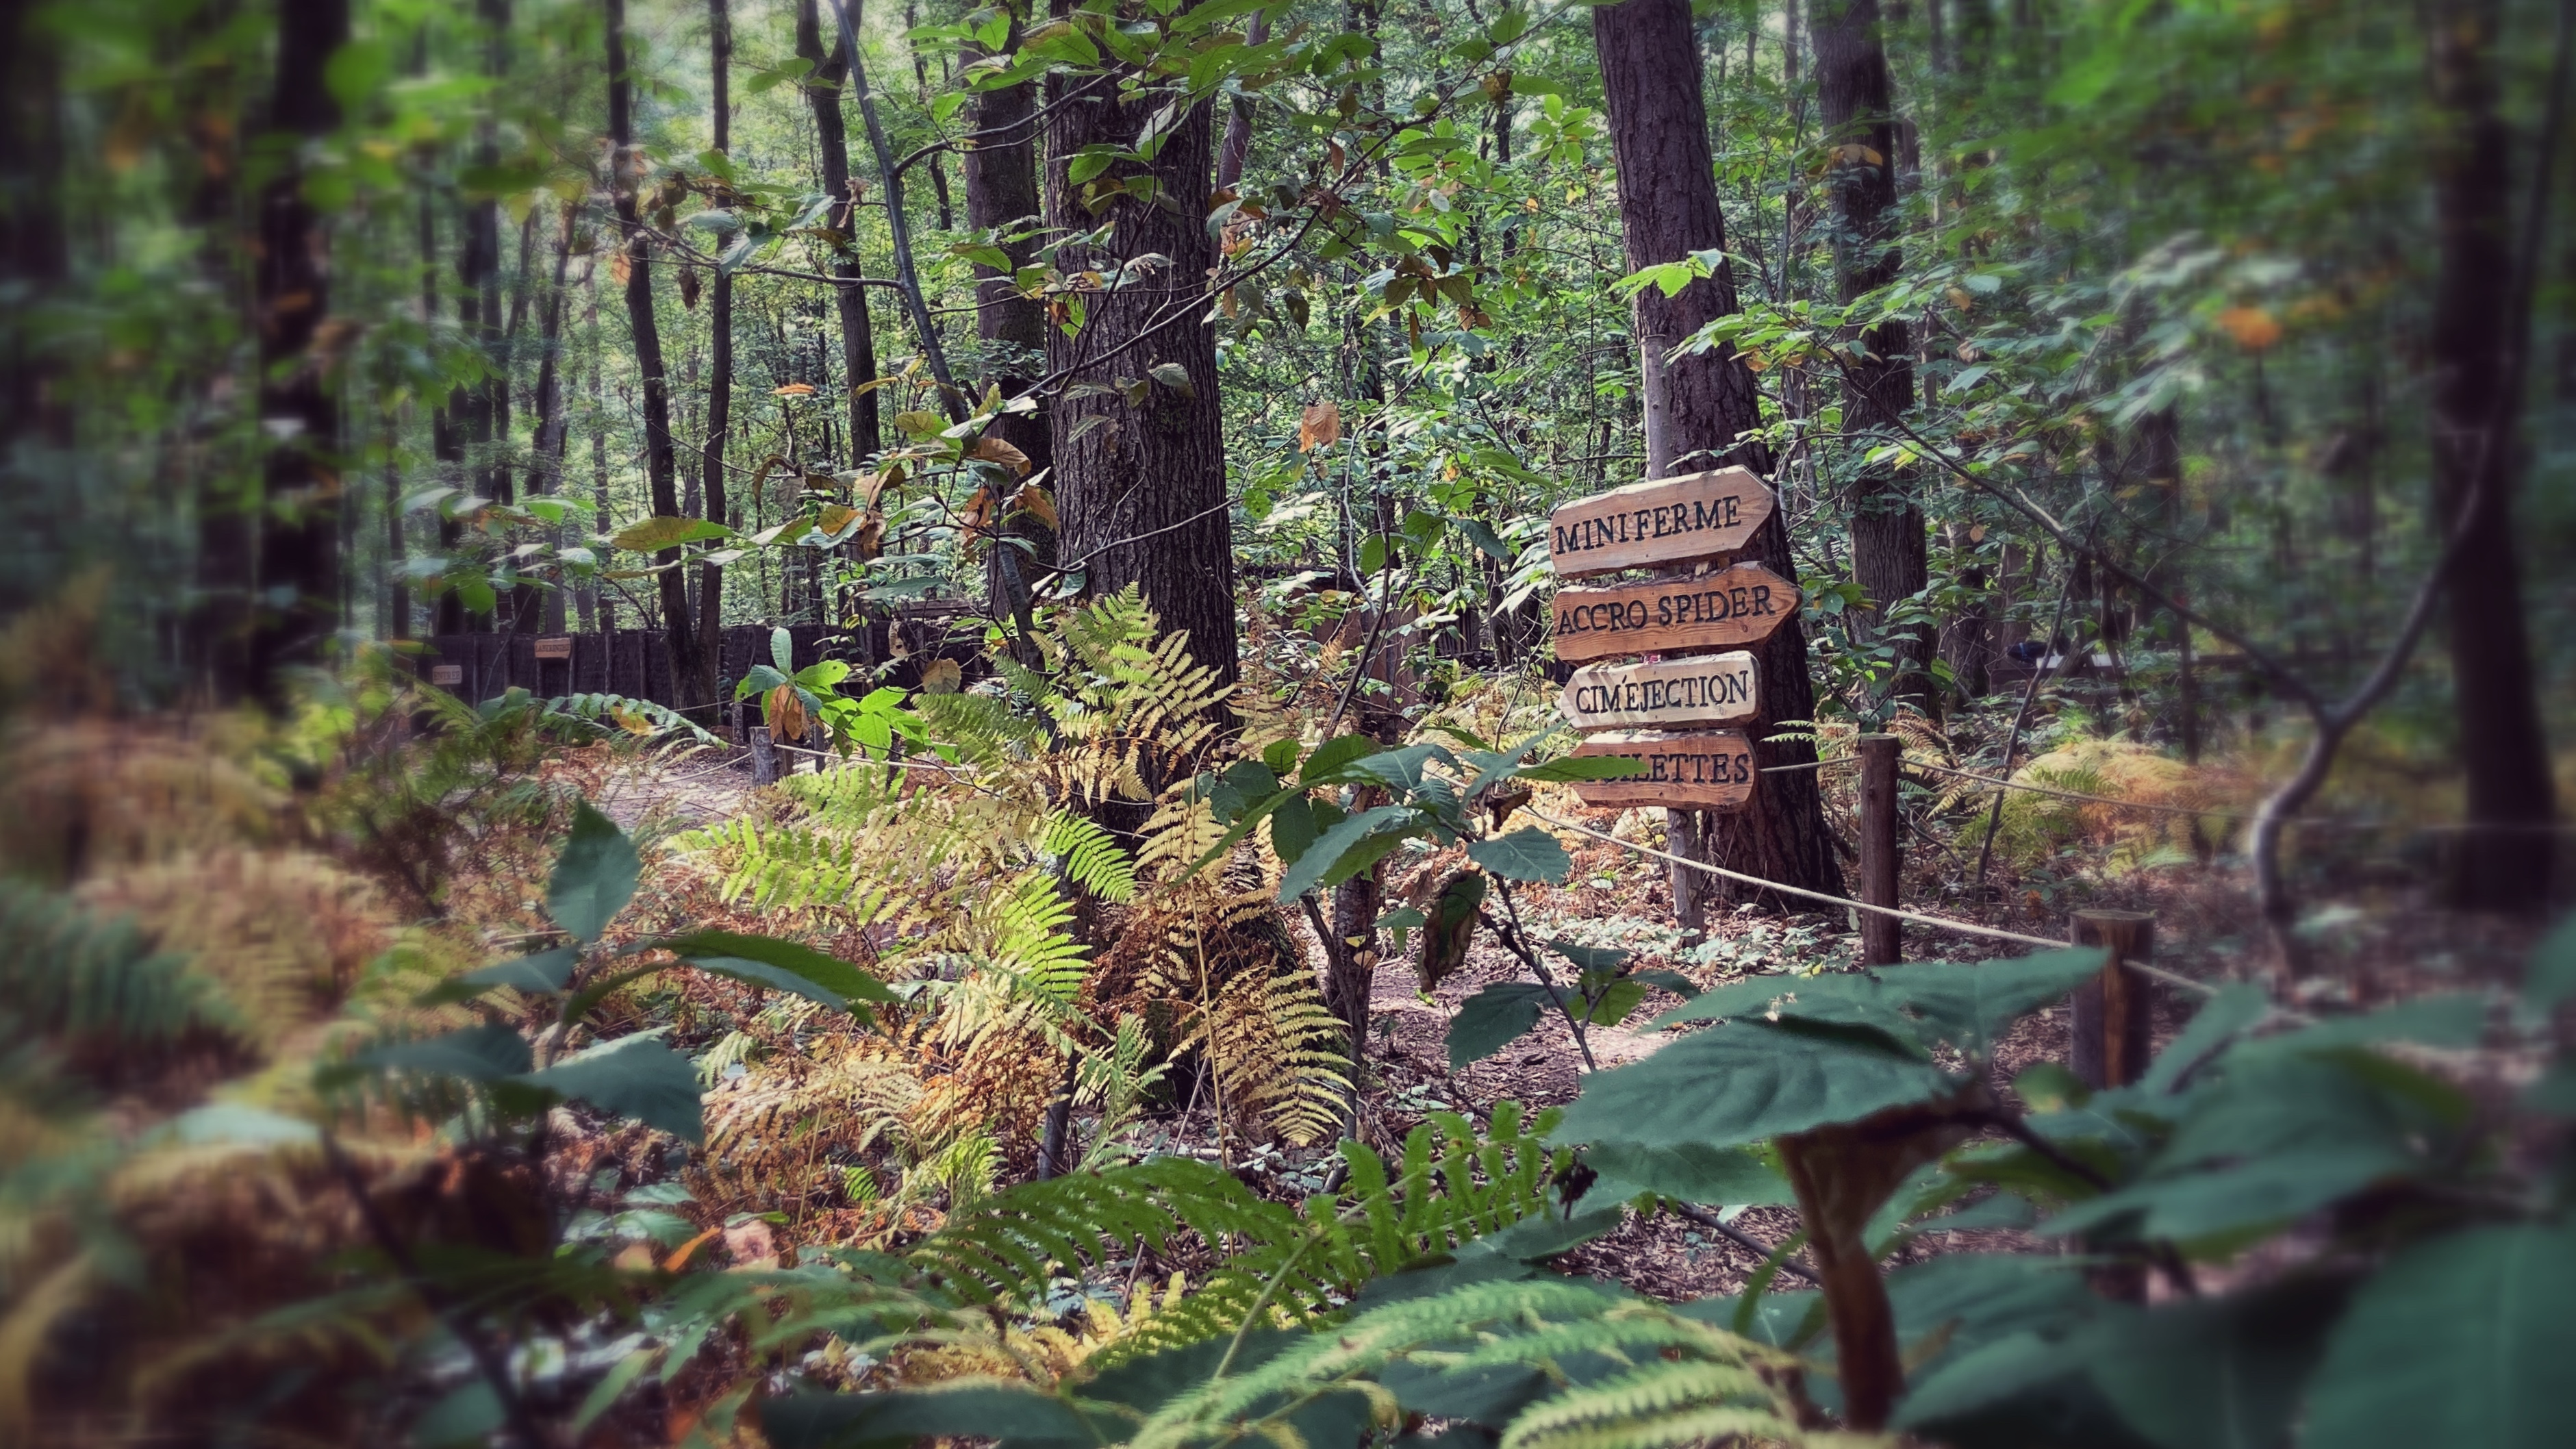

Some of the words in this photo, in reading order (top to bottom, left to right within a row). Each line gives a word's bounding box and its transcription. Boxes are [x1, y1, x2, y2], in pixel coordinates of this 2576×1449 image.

[1556, 600, 1648, 635] ACCRO
[1658, 585, 1776, 626] SPIDER
[1582, 753, 1750, 784] LETTES
